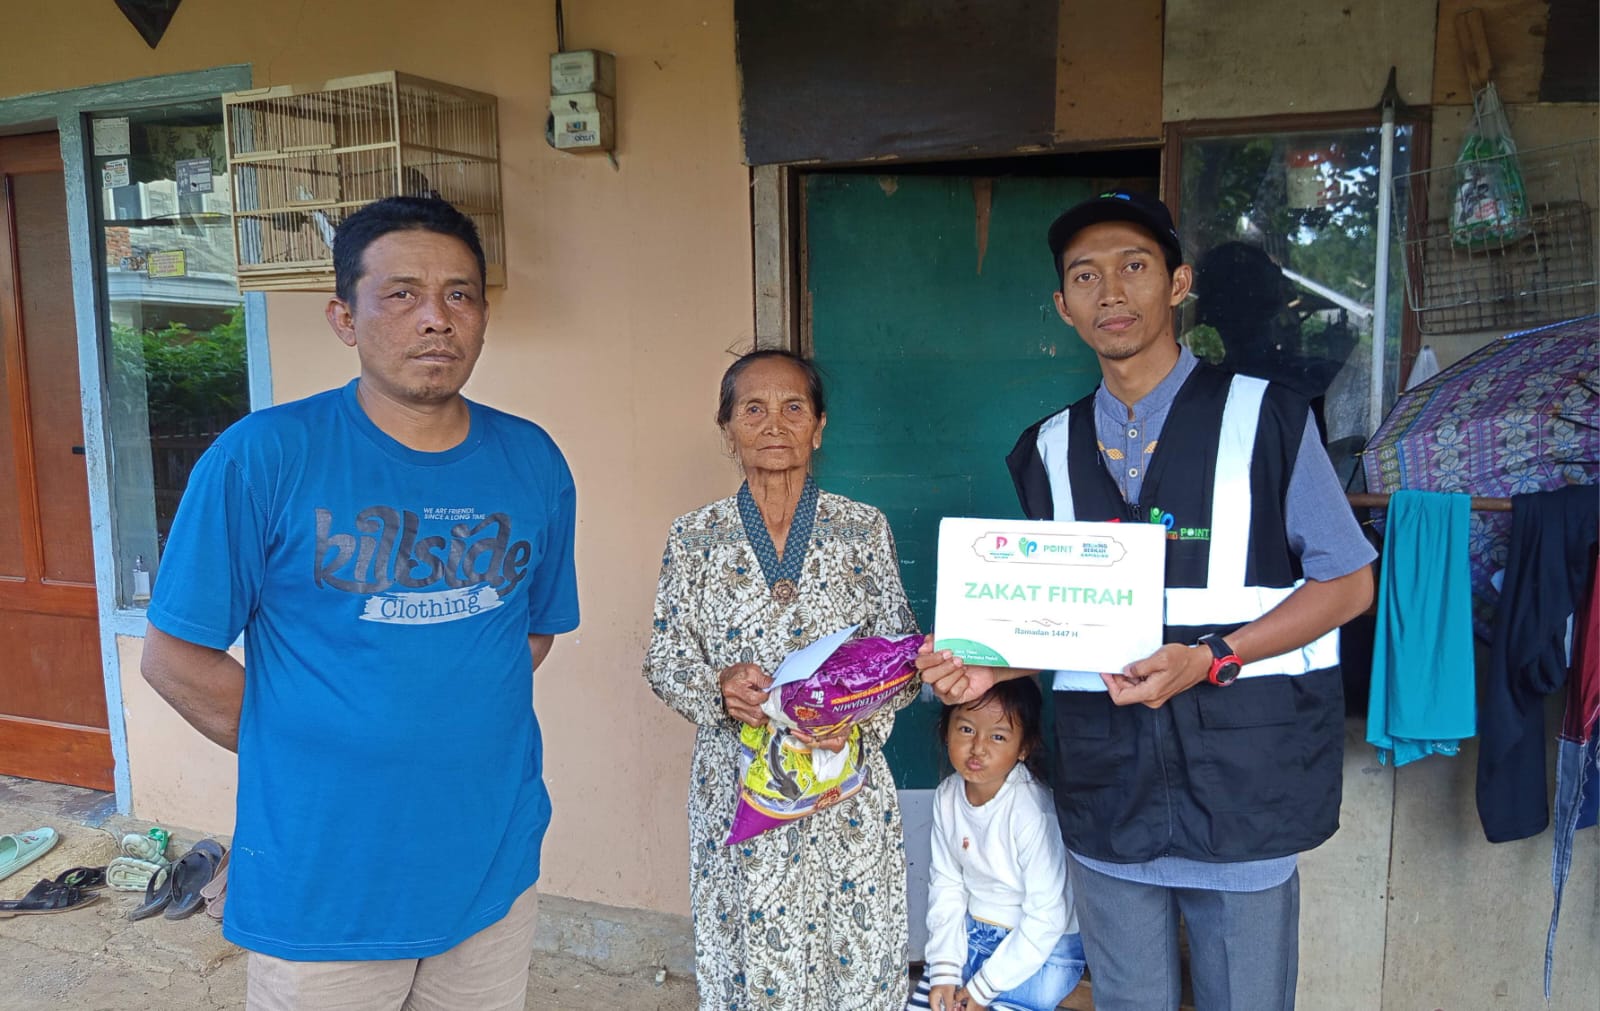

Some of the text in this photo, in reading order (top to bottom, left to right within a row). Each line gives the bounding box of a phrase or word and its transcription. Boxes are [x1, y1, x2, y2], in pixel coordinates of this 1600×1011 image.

[1180, 528, 1210, 537] POINT
[1043, 545, 1072, 553] POINT
[964, 582, 1133, 606] ZAKAT FITRAH
[381, 592, 481, 619] Clothing
[1014, 627, 1050, 636] Ramadan
[832, 697, 874, 713] TERJAMIN
